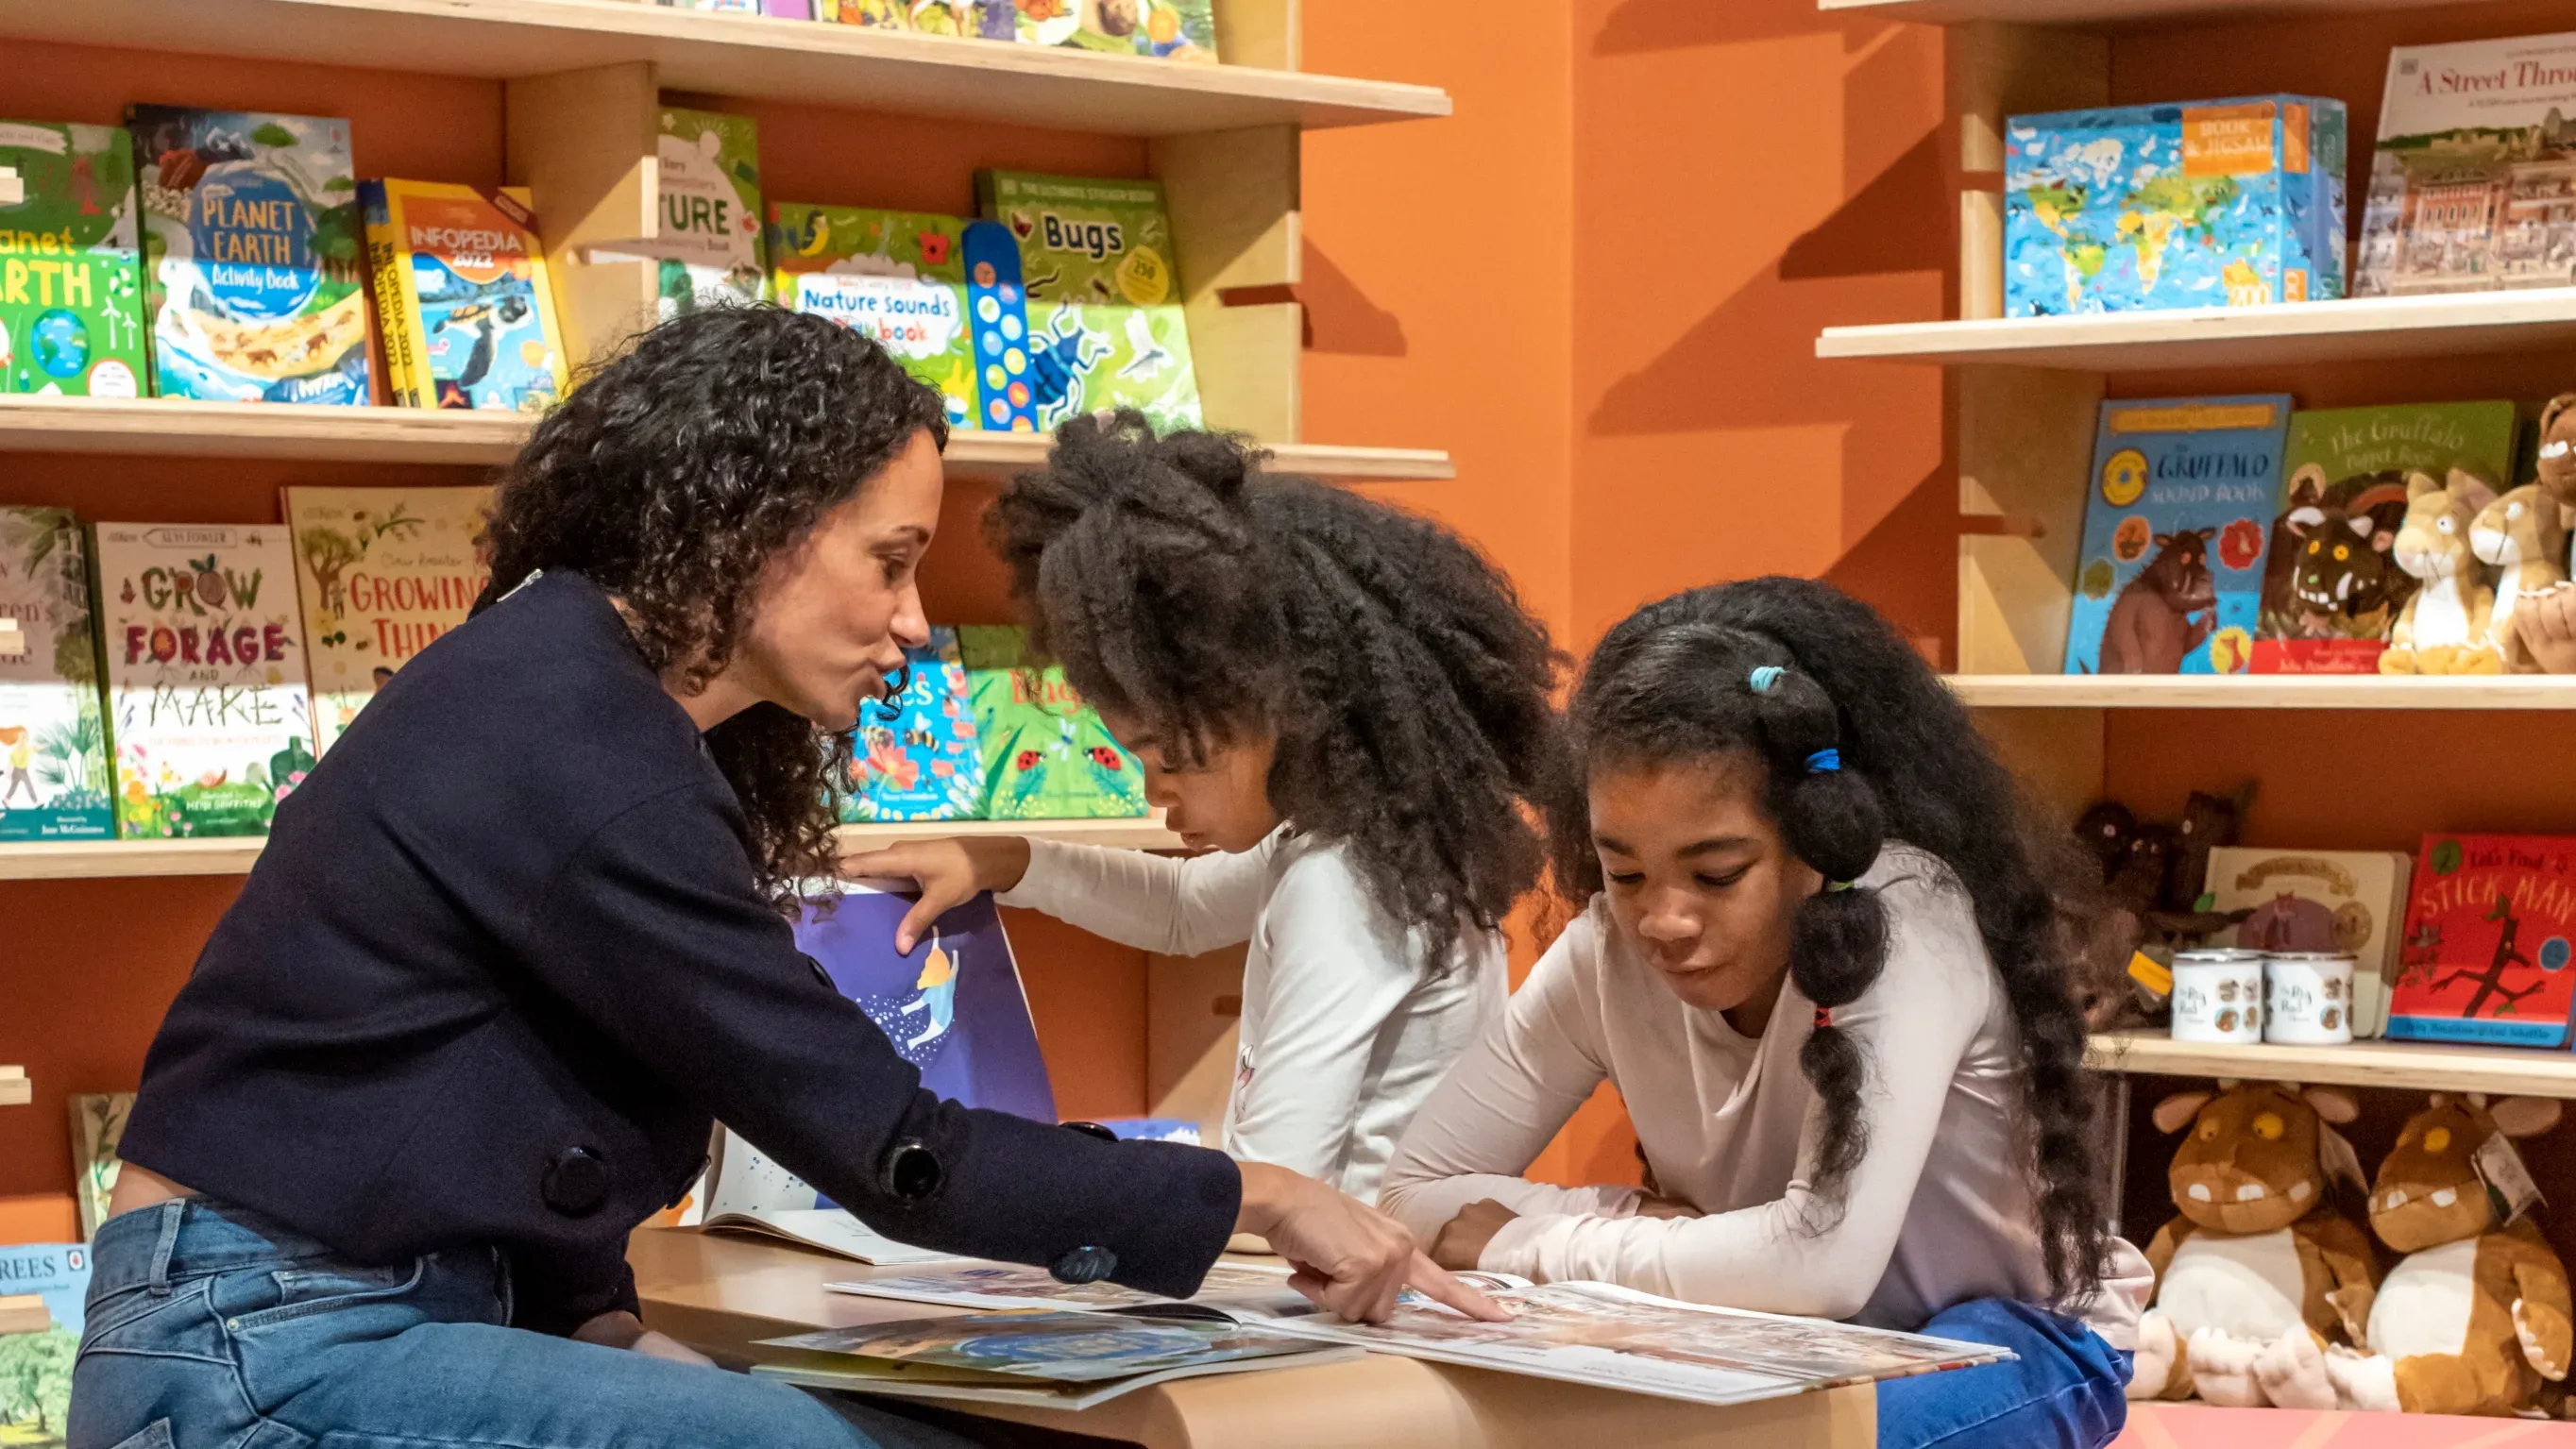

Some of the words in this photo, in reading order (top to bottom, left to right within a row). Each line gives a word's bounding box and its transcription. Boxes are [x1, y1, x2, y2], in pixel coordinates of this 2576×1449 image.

[2415, 70, 2432, 95] A
[2438, 68, 2506, 94] Street
[2200, 121, 2250, 137] BOOK
[2205, 136, 2272, 155] JIGSAW
[202, 197, 295, 231] PLANET
[213, 230, 291, 265] EARTH
[411, 226, 522, 252] INFOPEDIA
[1044, 214, 1122, 260] Bugs
[451, 250, 496, 269] 2022
[0, 258, 92, 308] RTH
[212, 263, 263, 295] Activity
[805, 289, 877, 312] Nature
[884, 294, 951, 317] sounds
[878, 315, 928, 342] book
[383, 329, 398, 367] 2022
[398, 329, 414, 367] 2022
[2331, 424, 2363, 455] The
[2371, 413, 2465, 450] Gruffalo
[2157, 453, 2269, 480] GRUFFALO
[2151, 484, 2211, 505] SOUND
[2215, 481, 2264, 502] BOOK
[142, 565, 263, 616] GROW
[126, 624, 285, 666] FORAGE
[190, 669, 219, 682] AND
[149, 680, 283, 728] MAKE
[2420, 872, 2502, 919] STICK
[2512, 873, 2576, 926] MAN
[0, 1255, 56, 1280] REES
